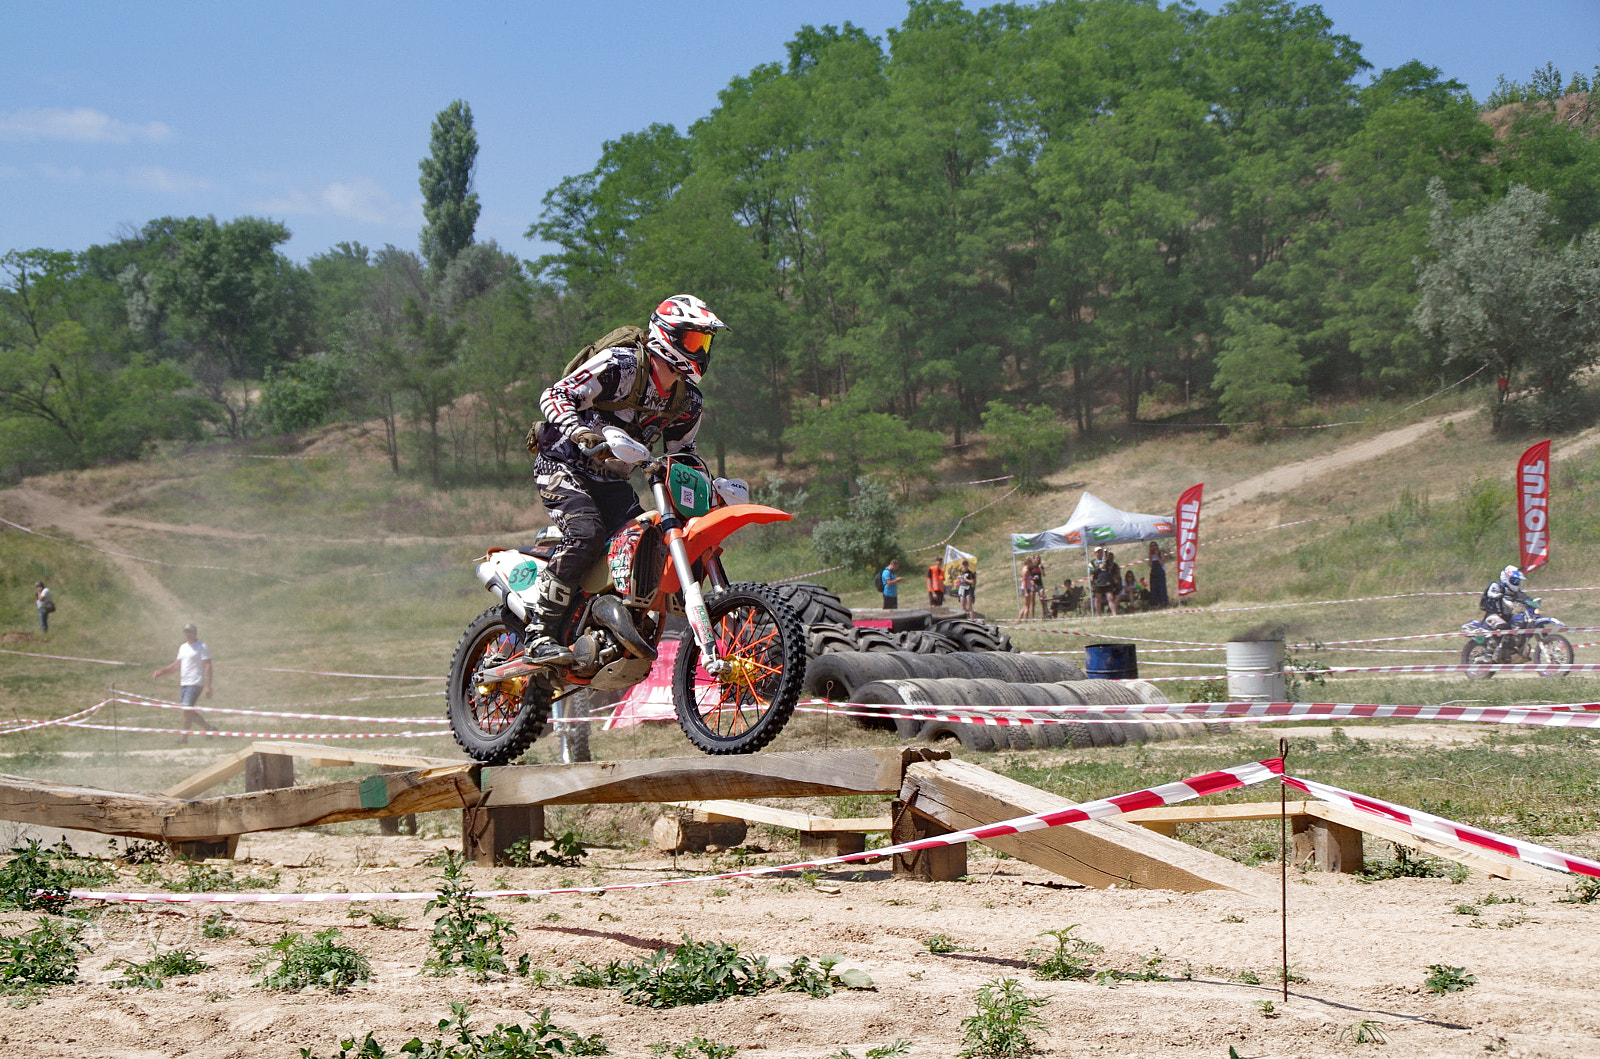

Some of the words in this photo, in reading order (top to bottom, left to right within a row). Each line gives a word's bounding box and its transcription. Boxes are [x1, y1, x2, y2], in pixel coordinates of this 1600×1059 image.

[674, 468, 698, 492] 397
[1523, 460, 1547, 556] MOTUL
[1179, 500, 1200, 583] MOTUL
[508, 567, 537, 586] 397
